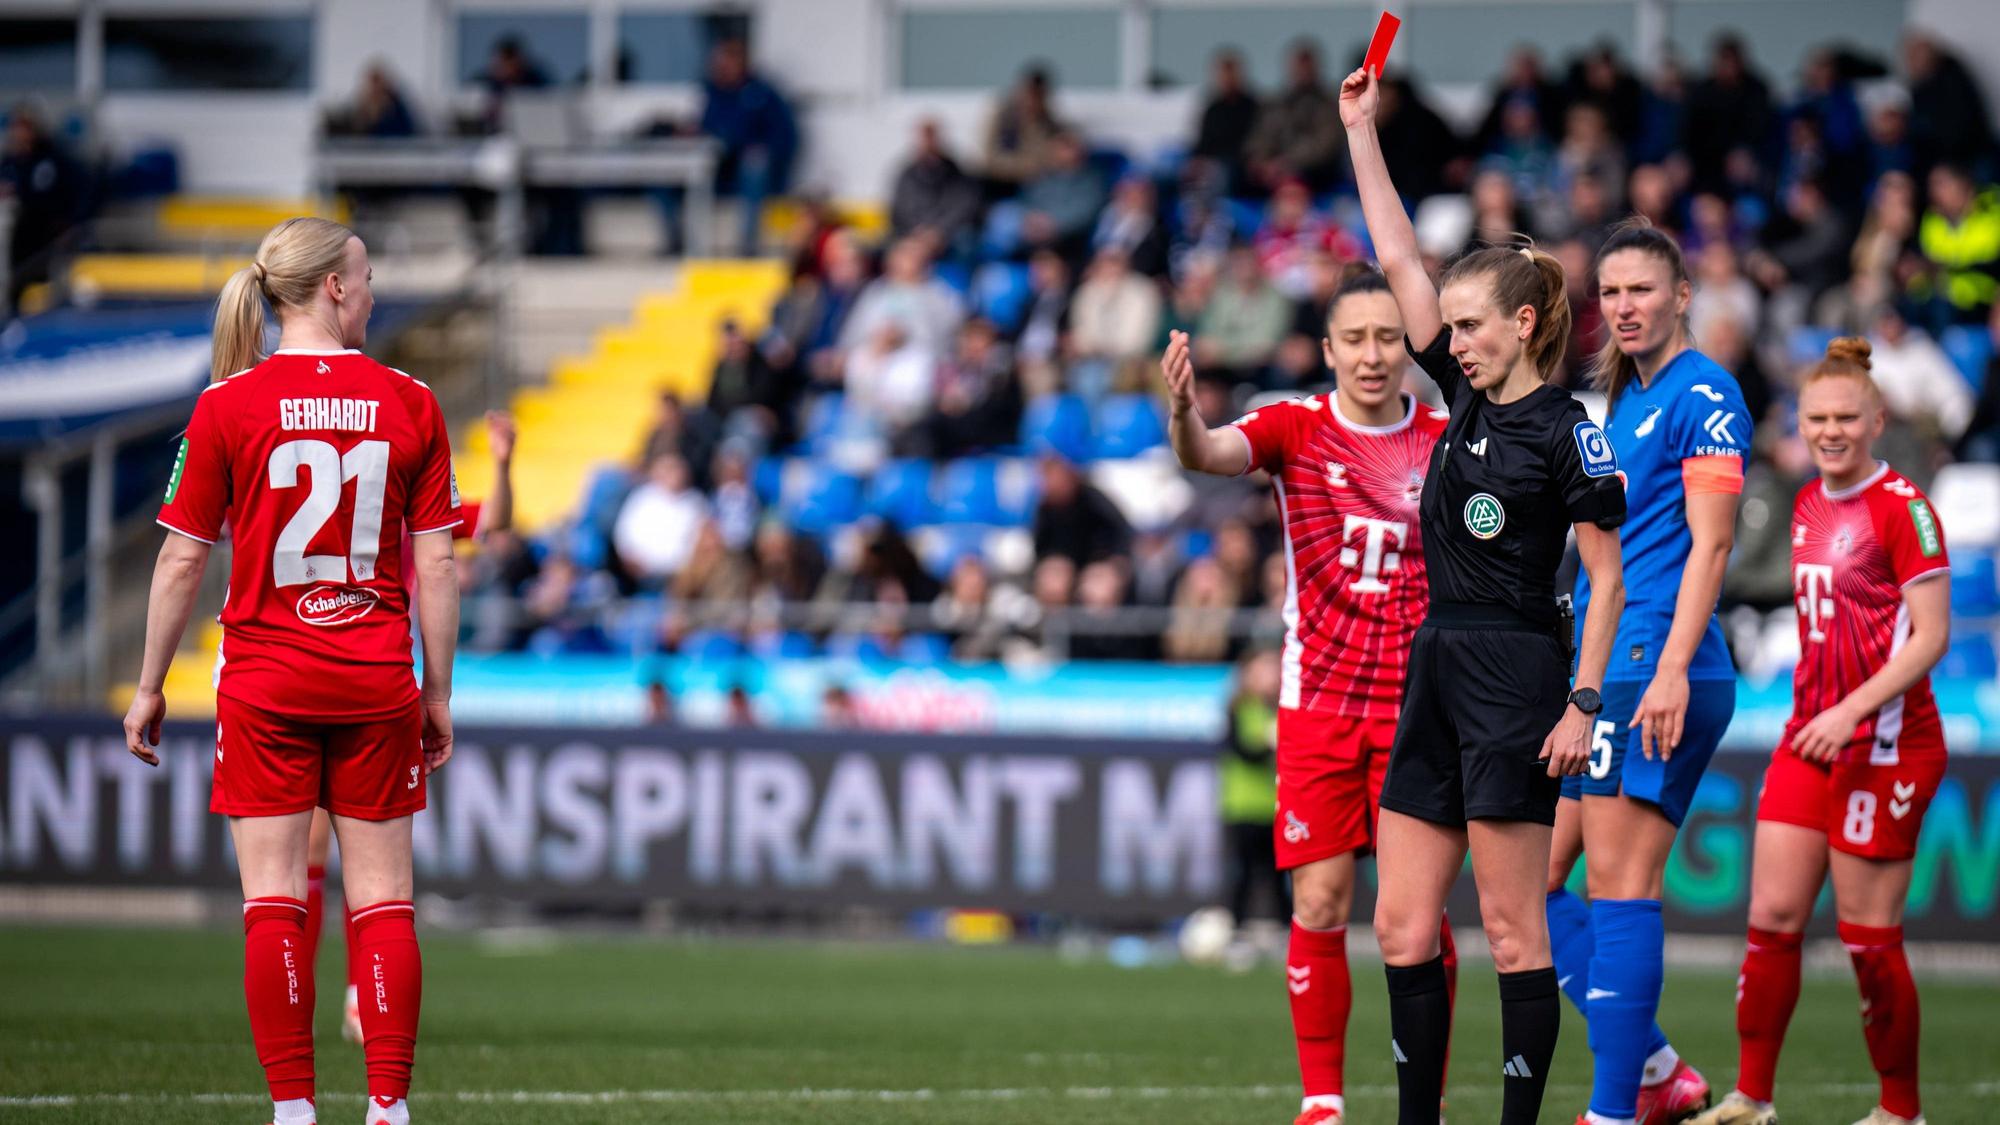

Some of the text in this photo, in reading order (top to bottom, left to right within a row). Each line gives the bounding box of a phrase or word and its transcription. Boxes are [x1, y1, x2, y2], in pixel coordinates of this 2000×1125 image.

[279, 398, 379, 432] GERHARDT
[268, 439, 390, 588] 21
[1913, 501, 1939, 553] DEVK
[1583, 719, 1616, 779] 5
[1843, 790, 1877, 845] 8
[283, 938, 294, 948] 1.
[373, 953, 384, 961] 1.
